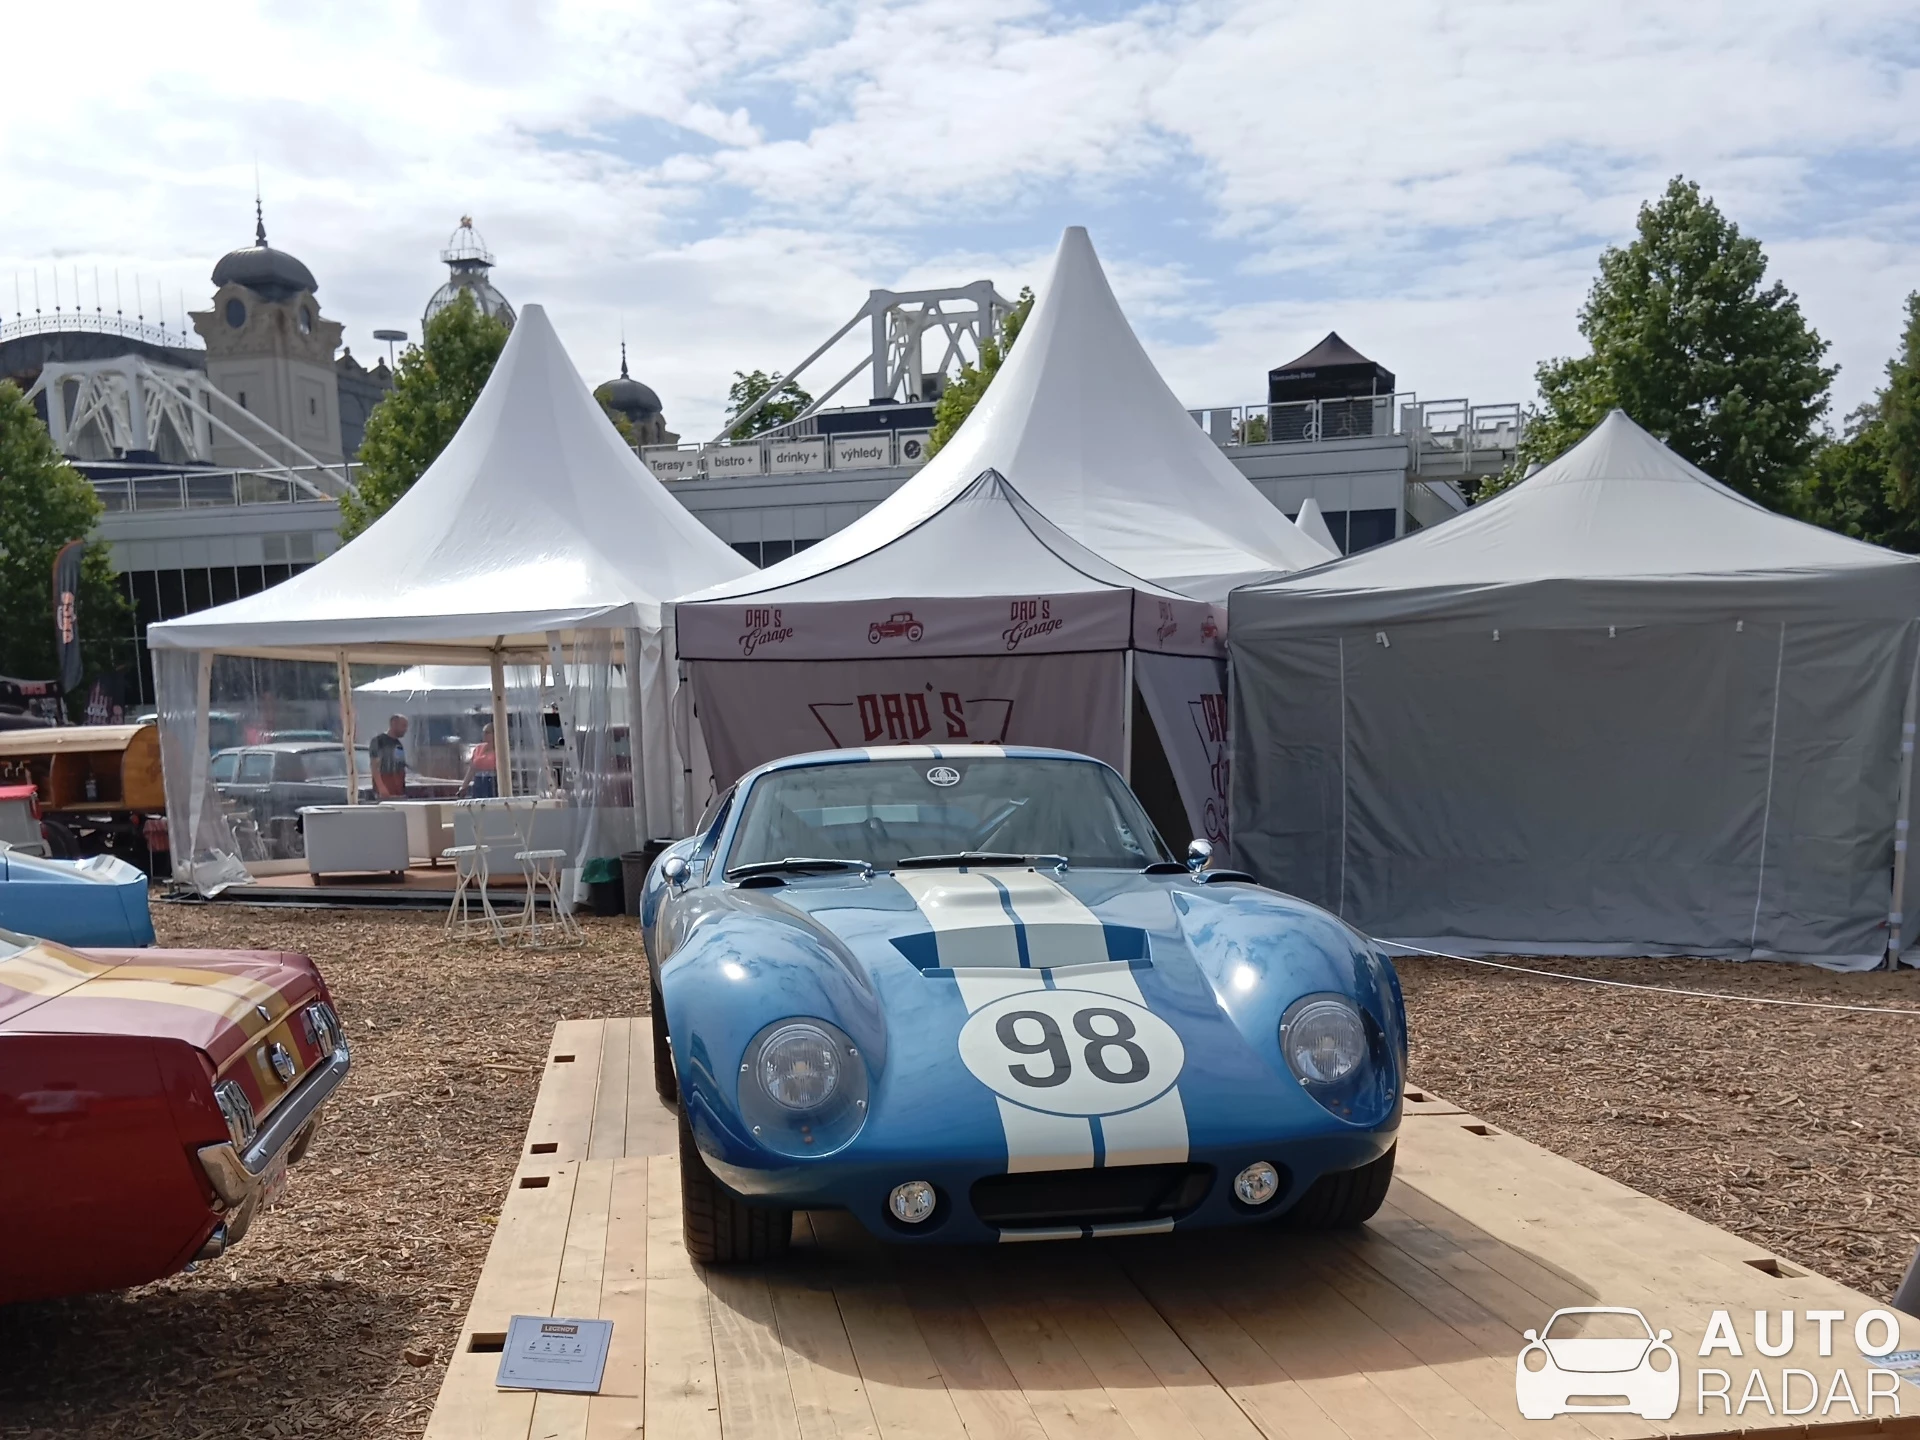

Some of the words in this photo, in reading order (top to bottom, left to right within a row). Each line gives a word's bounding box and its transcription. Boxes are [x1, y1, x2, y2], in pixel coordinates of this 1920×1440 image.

[650, 460, 685, 472] Terasy
[714, 456, 745, 467] bistro
[776, 451, 810, 464] drinky
[841, 446, 883, 462] výhledy
[738, 627, 793, 656] Garage
[1002, 618, 1063, 651] Garage
[856, 681, 968, 742] DAD'S
[995, 1007, 1150, 1088] 98
